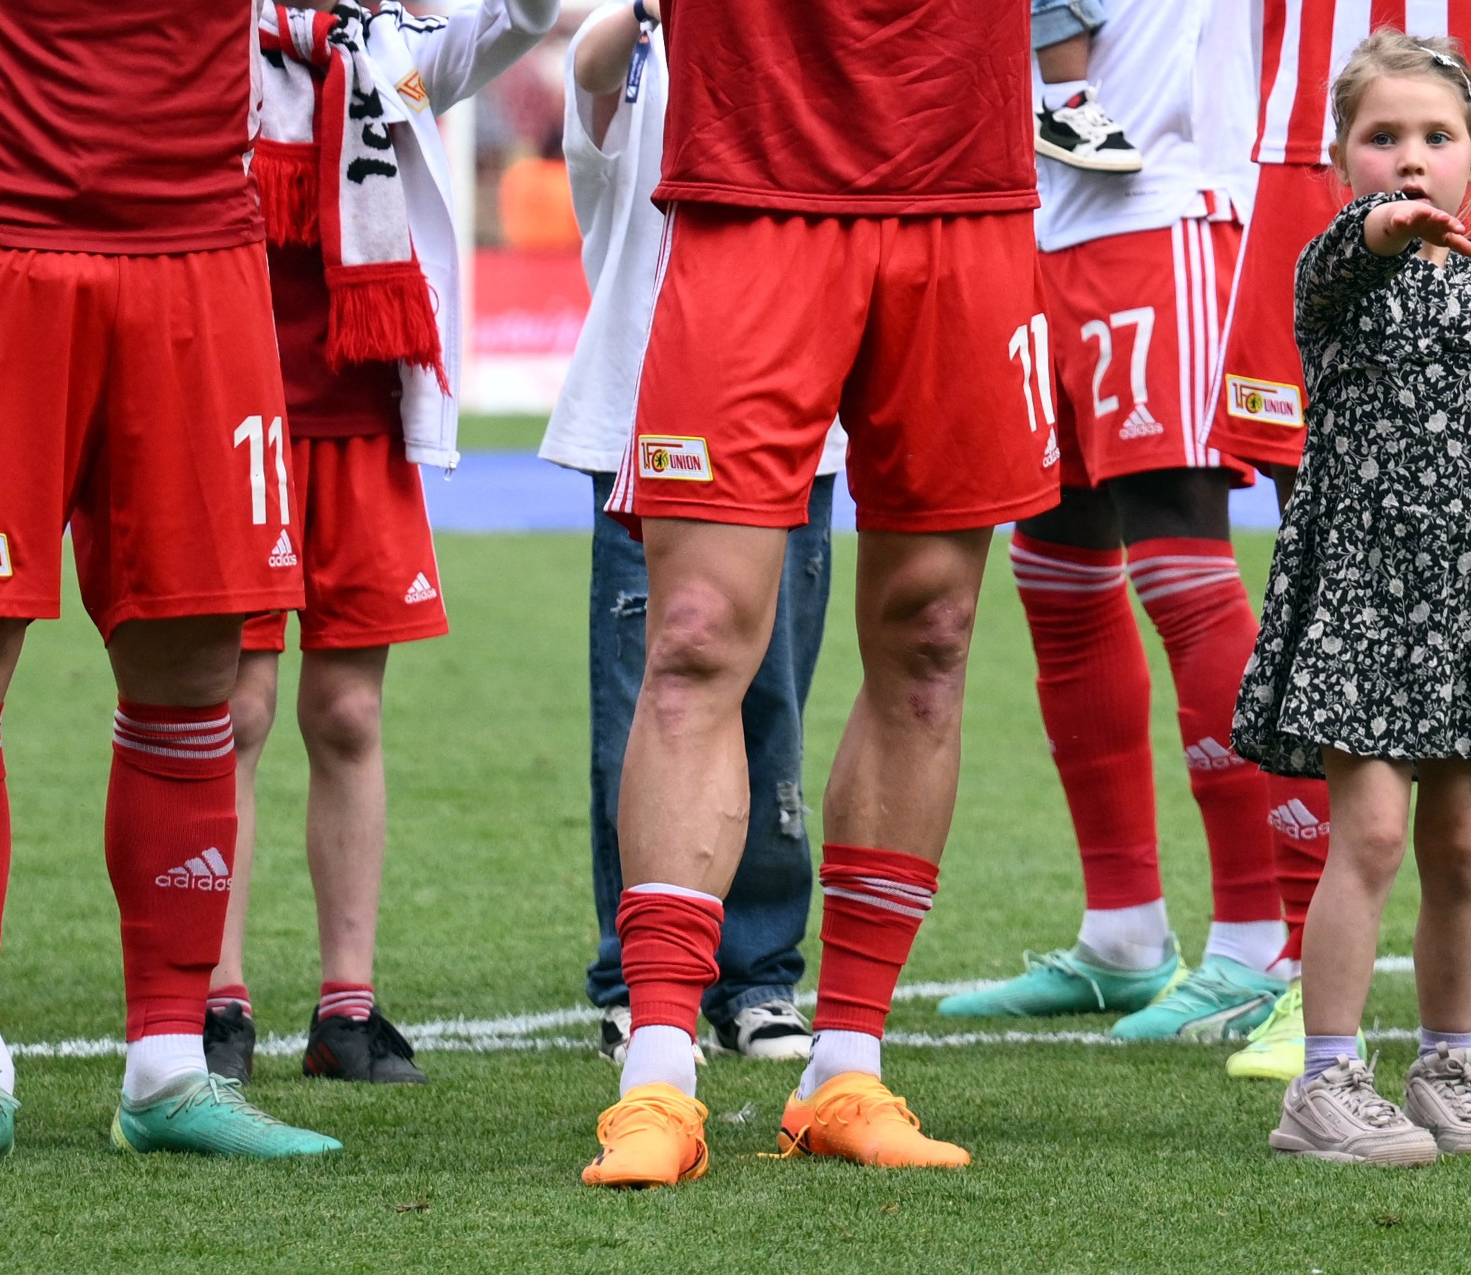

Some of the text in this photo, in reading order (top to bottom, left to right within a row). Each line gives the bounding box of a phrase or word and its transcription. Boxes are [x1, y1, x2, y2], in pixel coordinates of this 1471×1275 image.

[1080, 307, 1155, 417] 27
[1263, 398, 1294, 415] UNION
[1119, 422, 1164, 439] adidas
[669, 456, 701, 471] UNION
[268, 553, 296, 567] adidas
[404, 585, 437, 602] adidas
[155, 873, 233, 892] adidas
